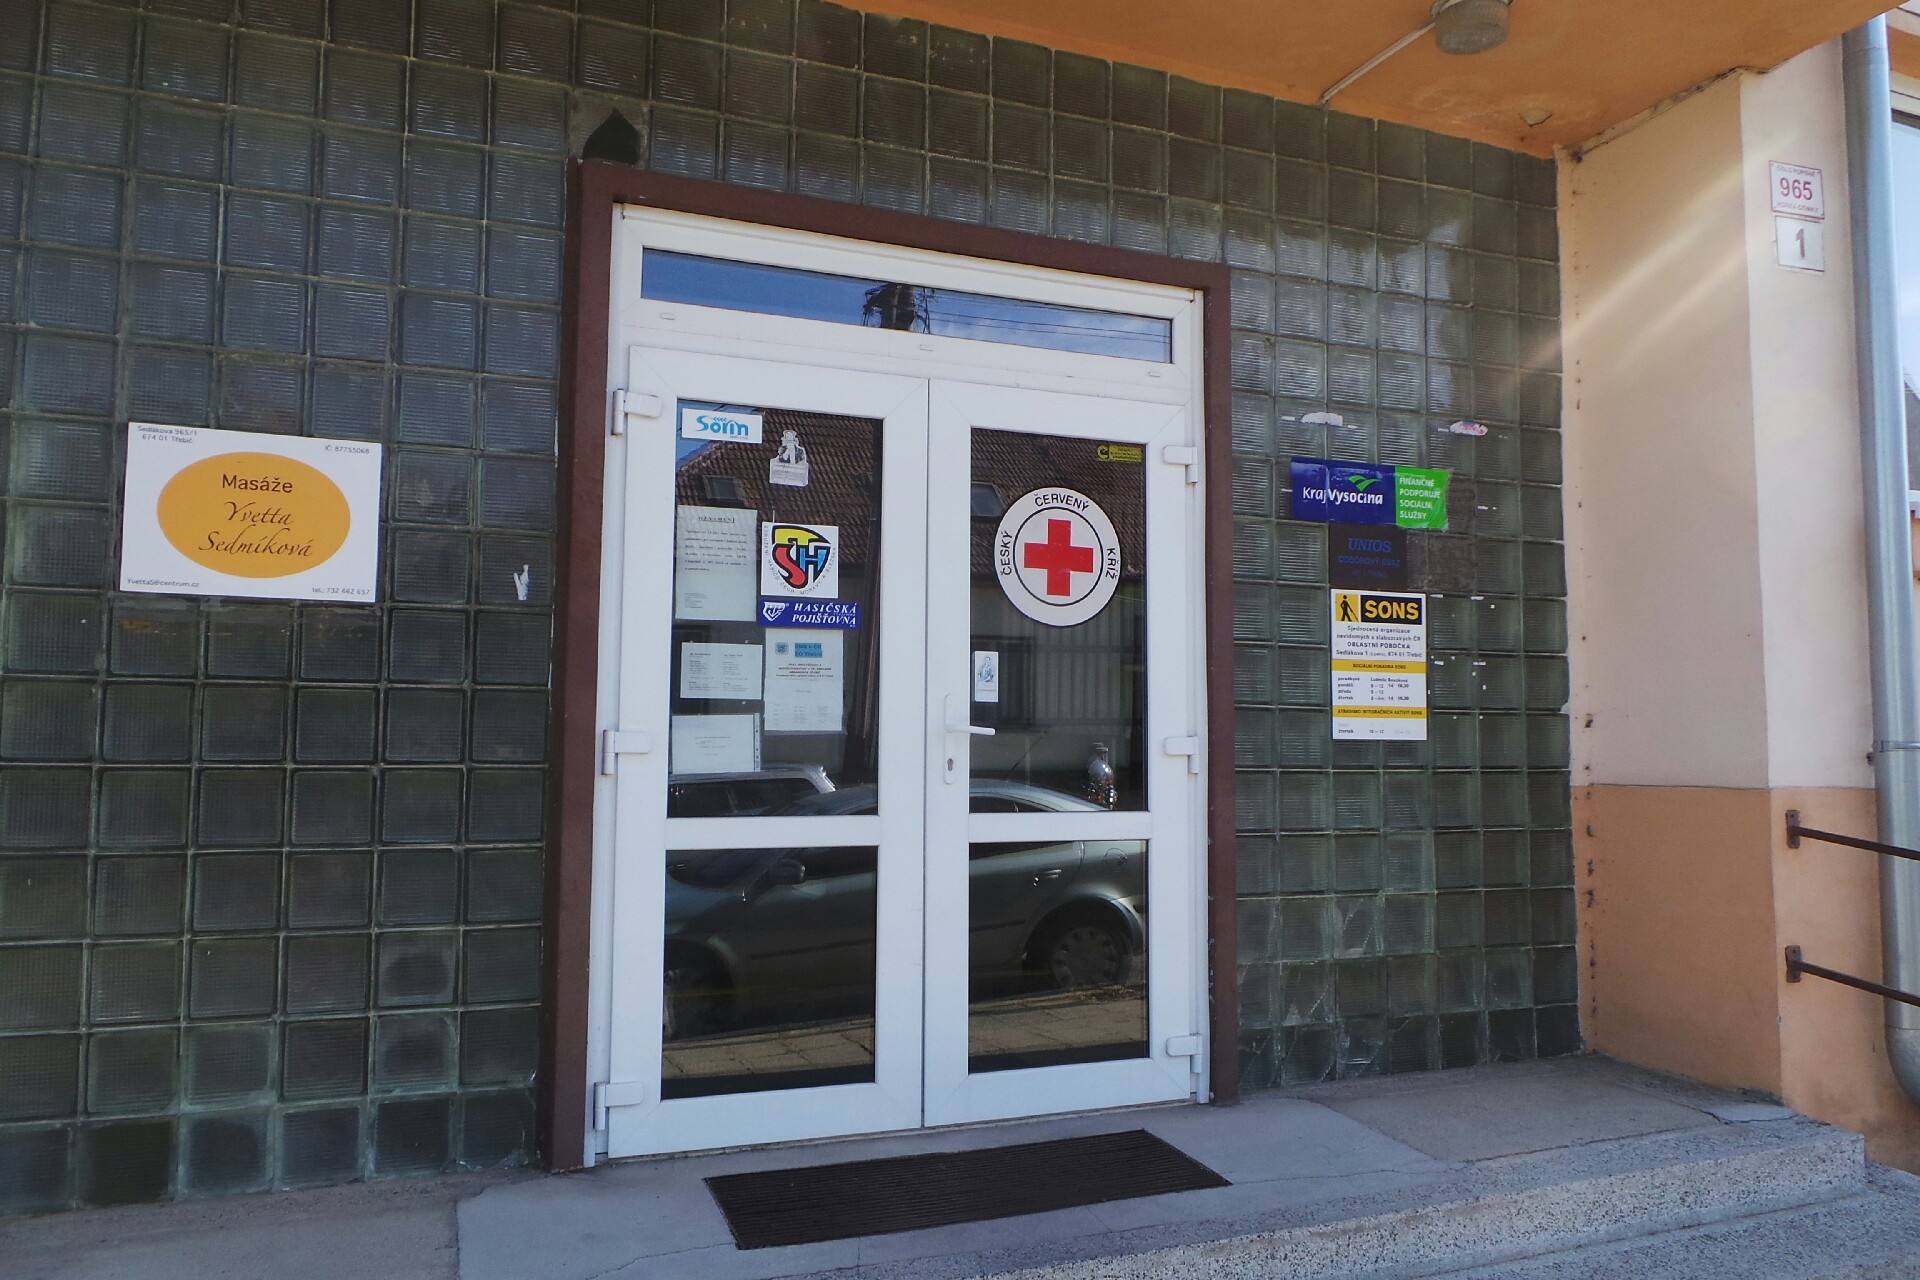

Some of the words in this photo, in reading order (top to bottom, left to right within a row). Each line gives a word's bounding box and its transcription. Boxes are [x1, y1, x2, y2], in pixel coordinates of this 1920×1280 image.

[1779, 177, 1813, 201] 965
[1795, 228, 1806, 258] 1
[222, 473, 293, 494] Masáže
[1399, 488, 1441, 498] PODPORUJE
[224, 501, 294, 526] Yvetta
[1399, 510, 1428, 519] SLUŽBY
[198, 524, 314, 558] Sedmíková
[1000, 530, 1013, 576] ČESKÝ
[1033, 492, 1090, 512] ČERVENÝ
[1105, 547, 1120, 580] KŘÍŽ
[1347, 538, 1392, 553] UNIOS
[794, 602, 856, 614] HASIČSKÁ
[1364, 600, 1419, 620] SONS
[1347, 625, 1379, 634] Sjednocená
